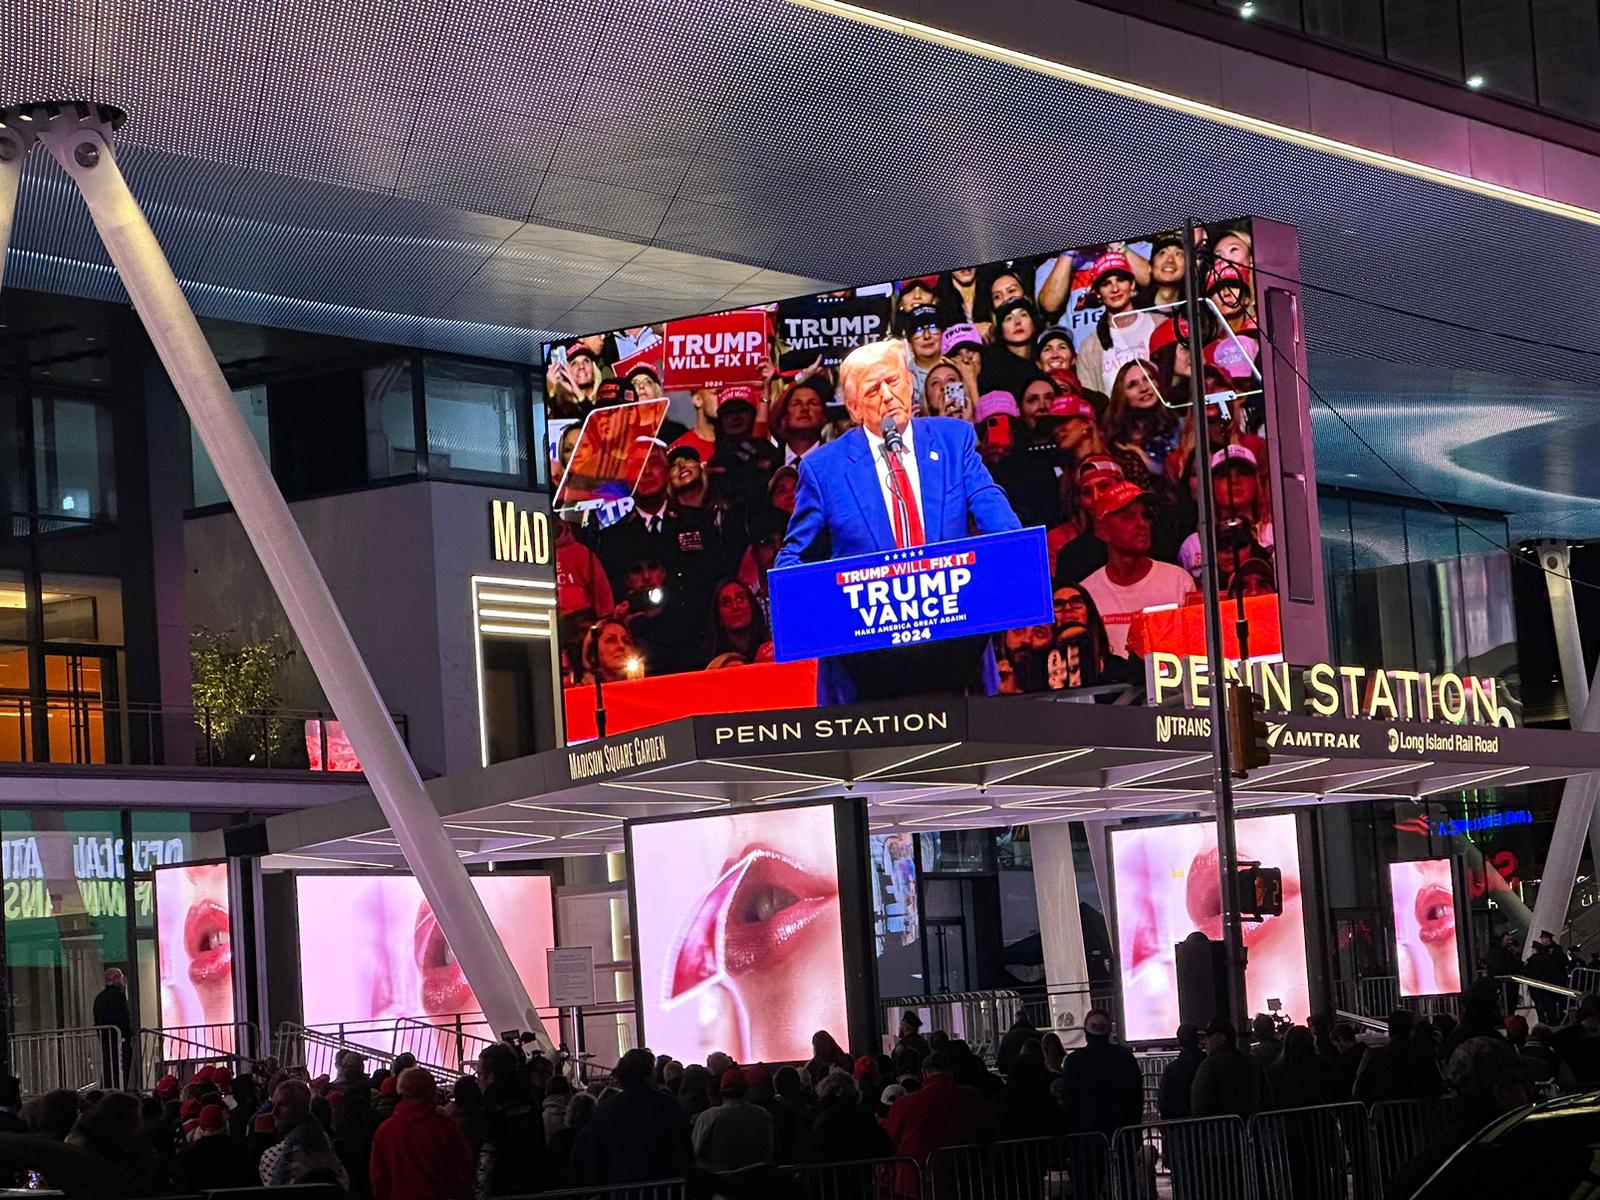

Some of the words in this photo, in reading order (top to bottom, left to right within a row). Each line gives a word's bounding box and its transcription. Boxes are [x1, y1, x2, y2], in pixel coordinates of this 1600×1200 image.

[784, 314, 881, 337] TRUMP
[668, 331, 762, 356] TRUMP
[786, 337, 829, 351] WILL
[833, 335, 860, 348] FIX
[668, 355, 710, 371] WILL
[714, 353, 741, 368] FIX
[745, 352, 762, 366] IT
[704, 380, 723, 388] 2024
[842, 566, 890, 583] TRUMP
[892, 562, 927, 576] WILL
[930, 554, 954, 570] FIX
[956, 553, 970, 566] IT
[843, 568, 972, 609] TRUMP
[859, 594, 960, 627] VANCE
[854, 627, 876, 637] MAKE
[878, 622, 912, 634] AMERICA
[913, 618, 938, 628] GREAT
[892, 627, 931, 645] 2024
[1310, 662, 1498, 727] STATION
[715, 722, 802, 745] PENN
[814, 711, 948, 738] STATION
[1282, 730, 1361, 749] AMTRAK
[1400, 732, 1424, 754] Long
[1426, 733, 1454, 751] Island
[1455, 734, 1474, 752] Rail
[1474, 736, 1499, 753] Road
